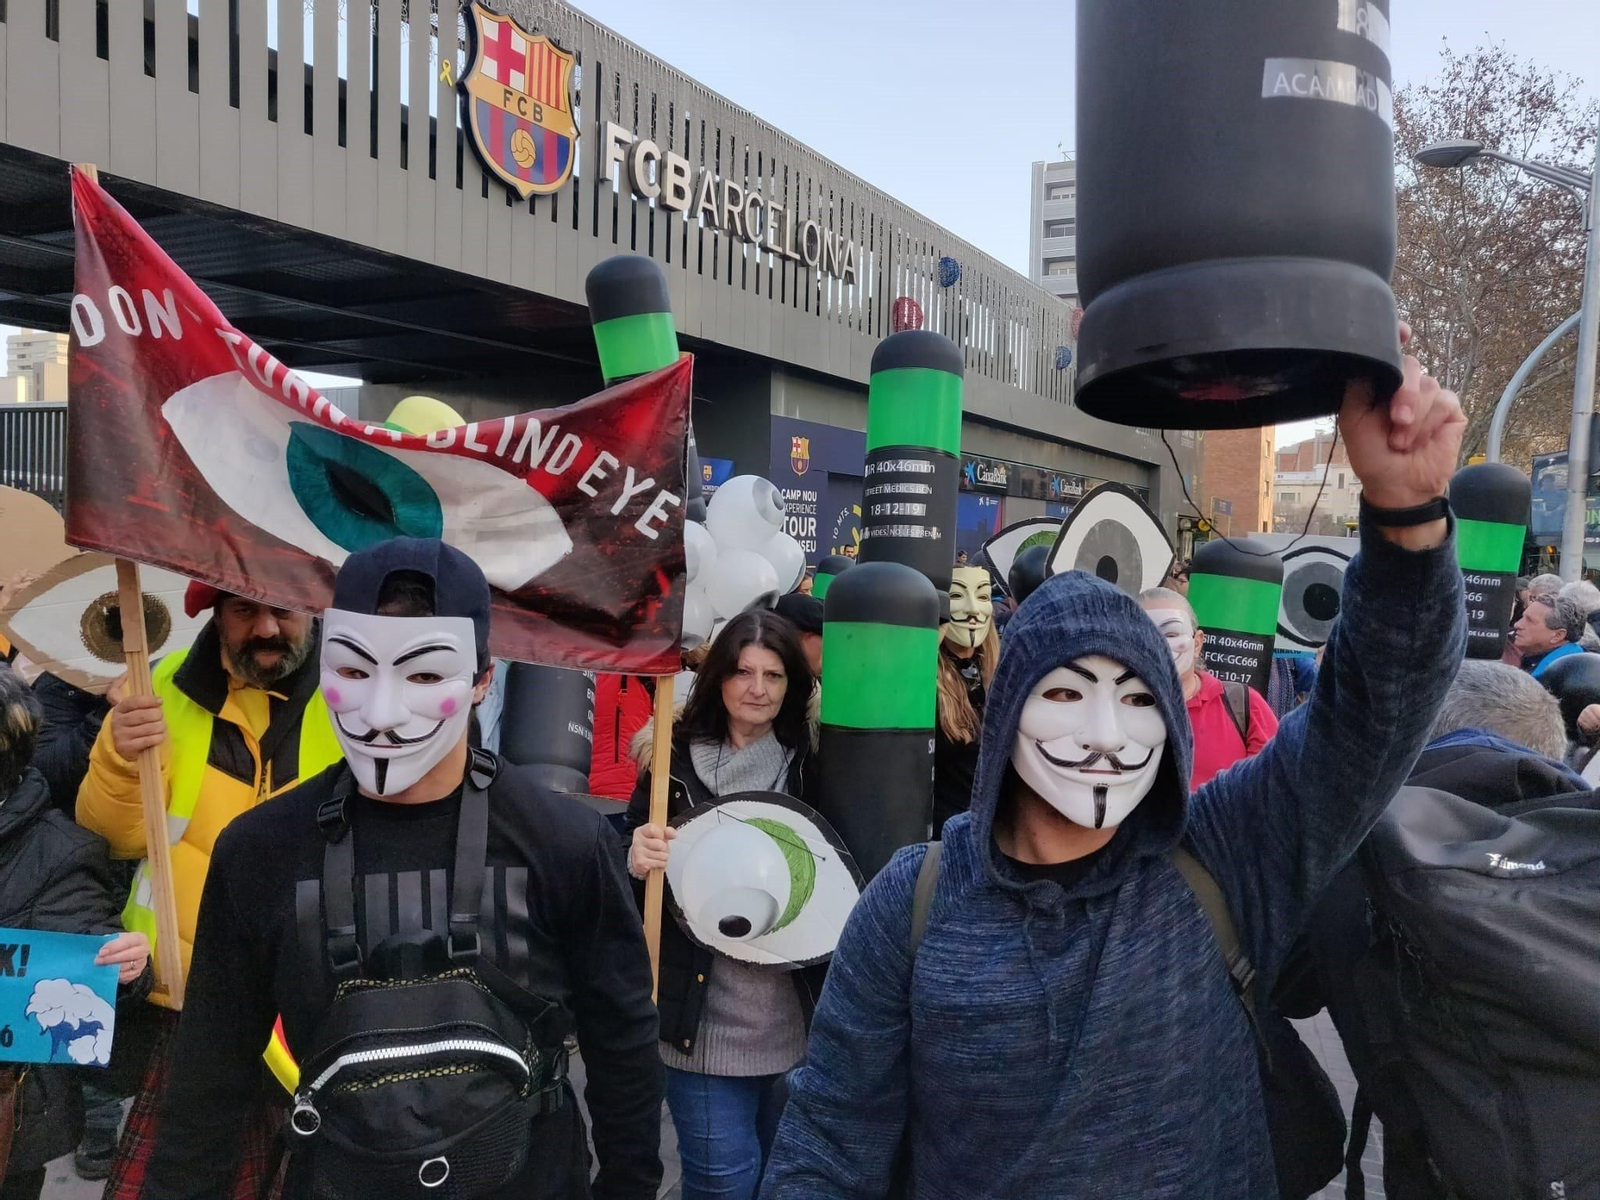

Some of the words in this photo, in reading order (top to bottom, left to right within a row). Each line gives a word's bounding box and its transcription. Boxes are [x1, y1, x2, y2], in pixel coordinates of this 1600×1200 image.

[503, 88, 543, 123] FCB
[877, 461, 935, 473] 40x46mm
[976, 464, 1007, 485] CaixaBank
[576, 450, 681, 540] EYE
[781, 488, 801, 501] CAMP
[803, 491, 818, 502] NOU
[784, 502, 818, 515] XPERIENCE
[783, 515, 817, 537] TOUR
[1463, 574, 1501, 587] 46mm
[1202, 633, 1216, 646] SIR
[1218, 636, 1265, 652] 40x46mm
[1205, 651, 1258, 668] FCK-GC666
[568, 721, 583, 736] NSN
